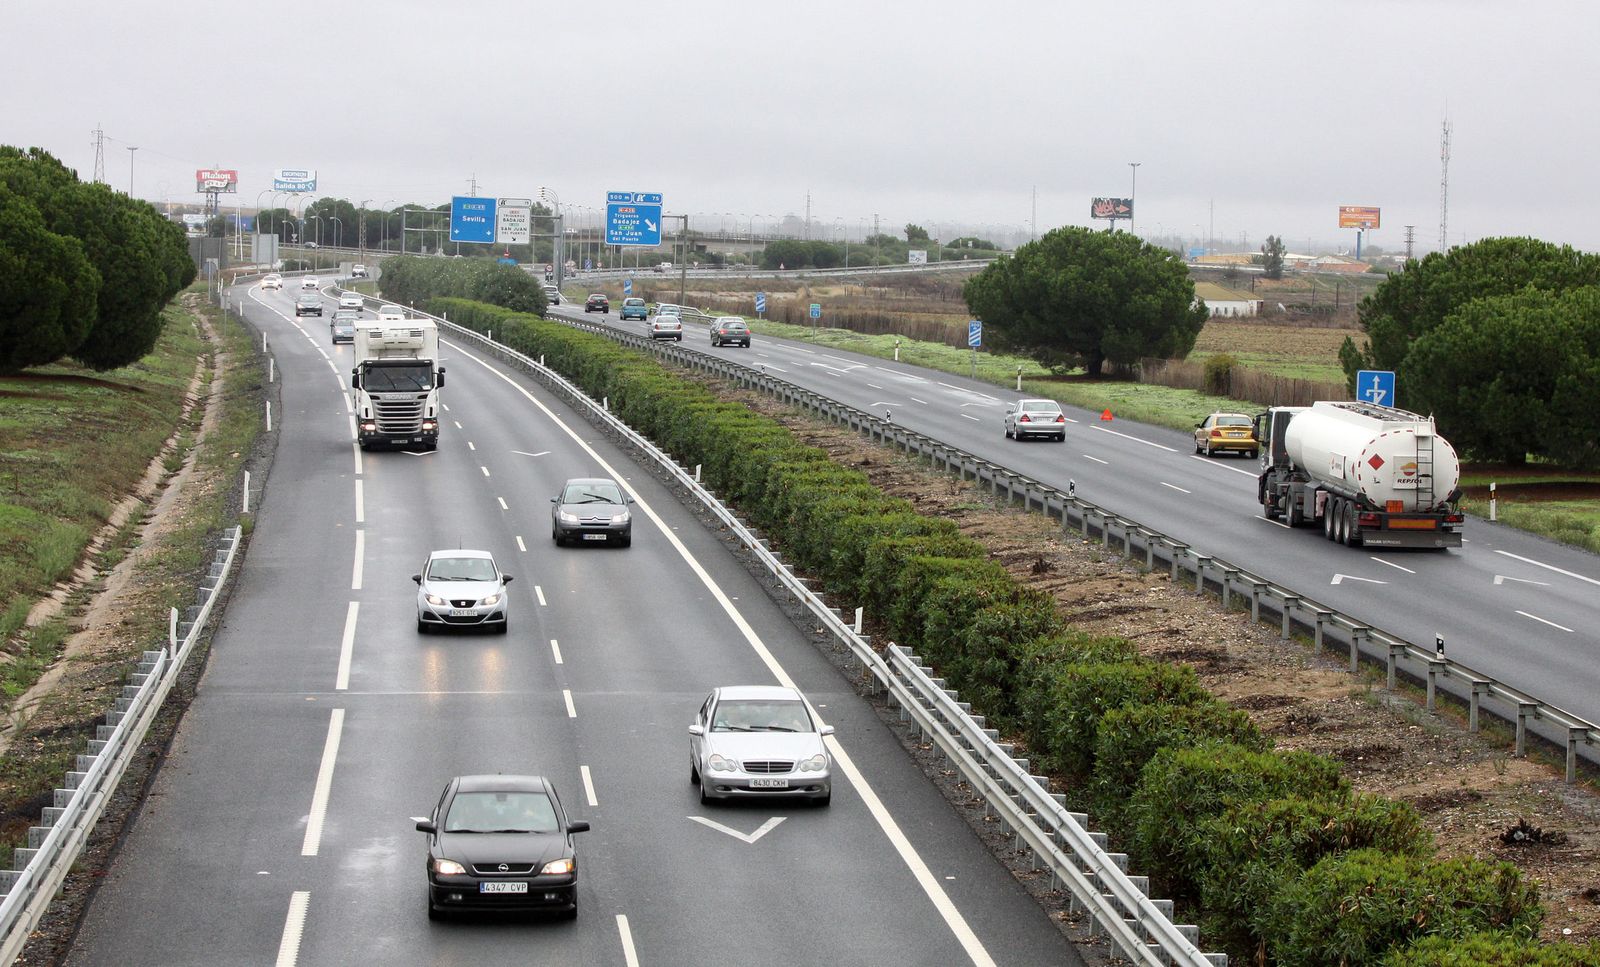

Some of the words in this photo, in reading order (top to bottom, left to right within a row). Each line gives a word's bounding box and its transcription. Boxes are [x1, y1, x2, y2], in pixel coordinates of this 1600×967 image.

[275, 182, 296, 190] Salida
[462, 215, 486, 223] Sevilla
[612, 218, 640, 226] Badajoz
[486, 884, 506, 892] 4347
[510, 884, 526, 892] CVP
